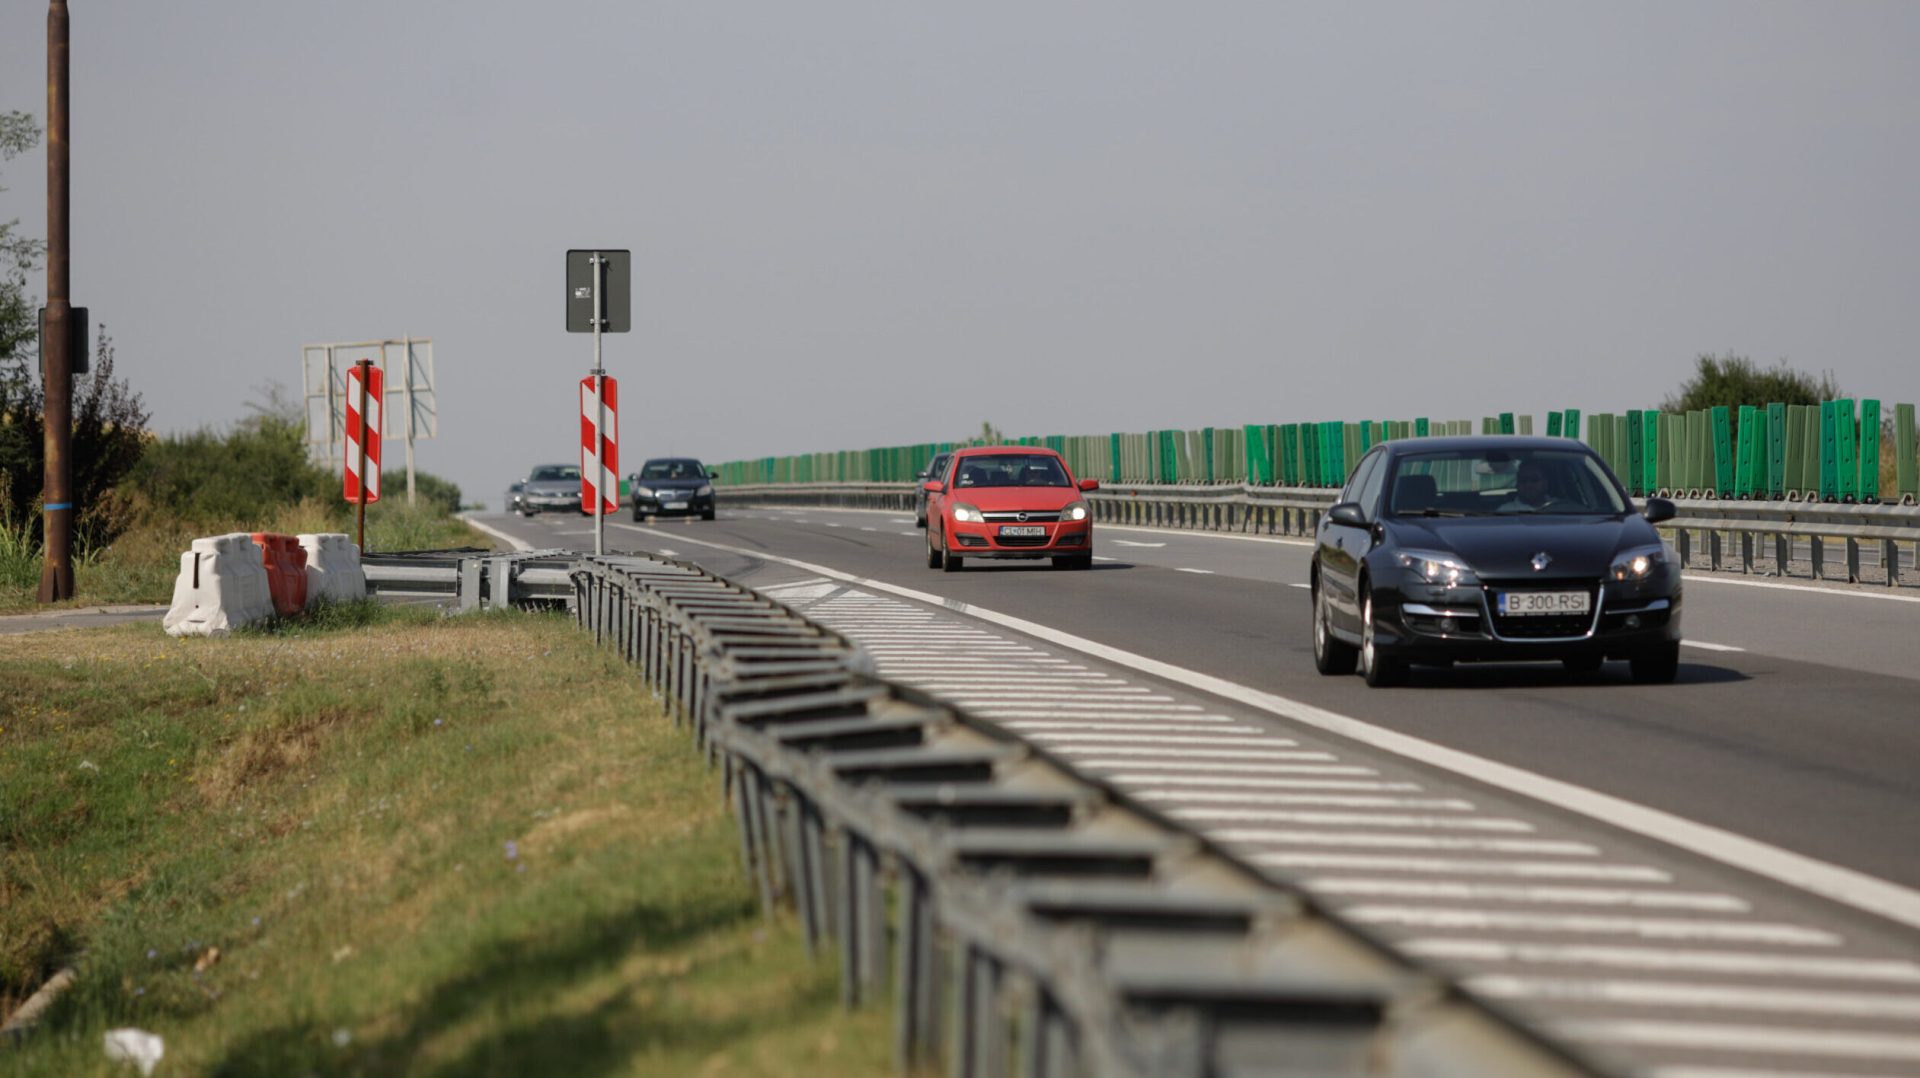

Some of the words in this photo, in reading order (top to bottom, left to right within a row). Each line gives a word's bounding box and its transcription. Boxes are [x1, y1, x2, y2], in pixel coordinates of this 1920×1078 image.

[1509, 595, 1521, 610] B
[1527, 595, 1554, 610] 300
[1559, 594, 1585, 609] RSI
